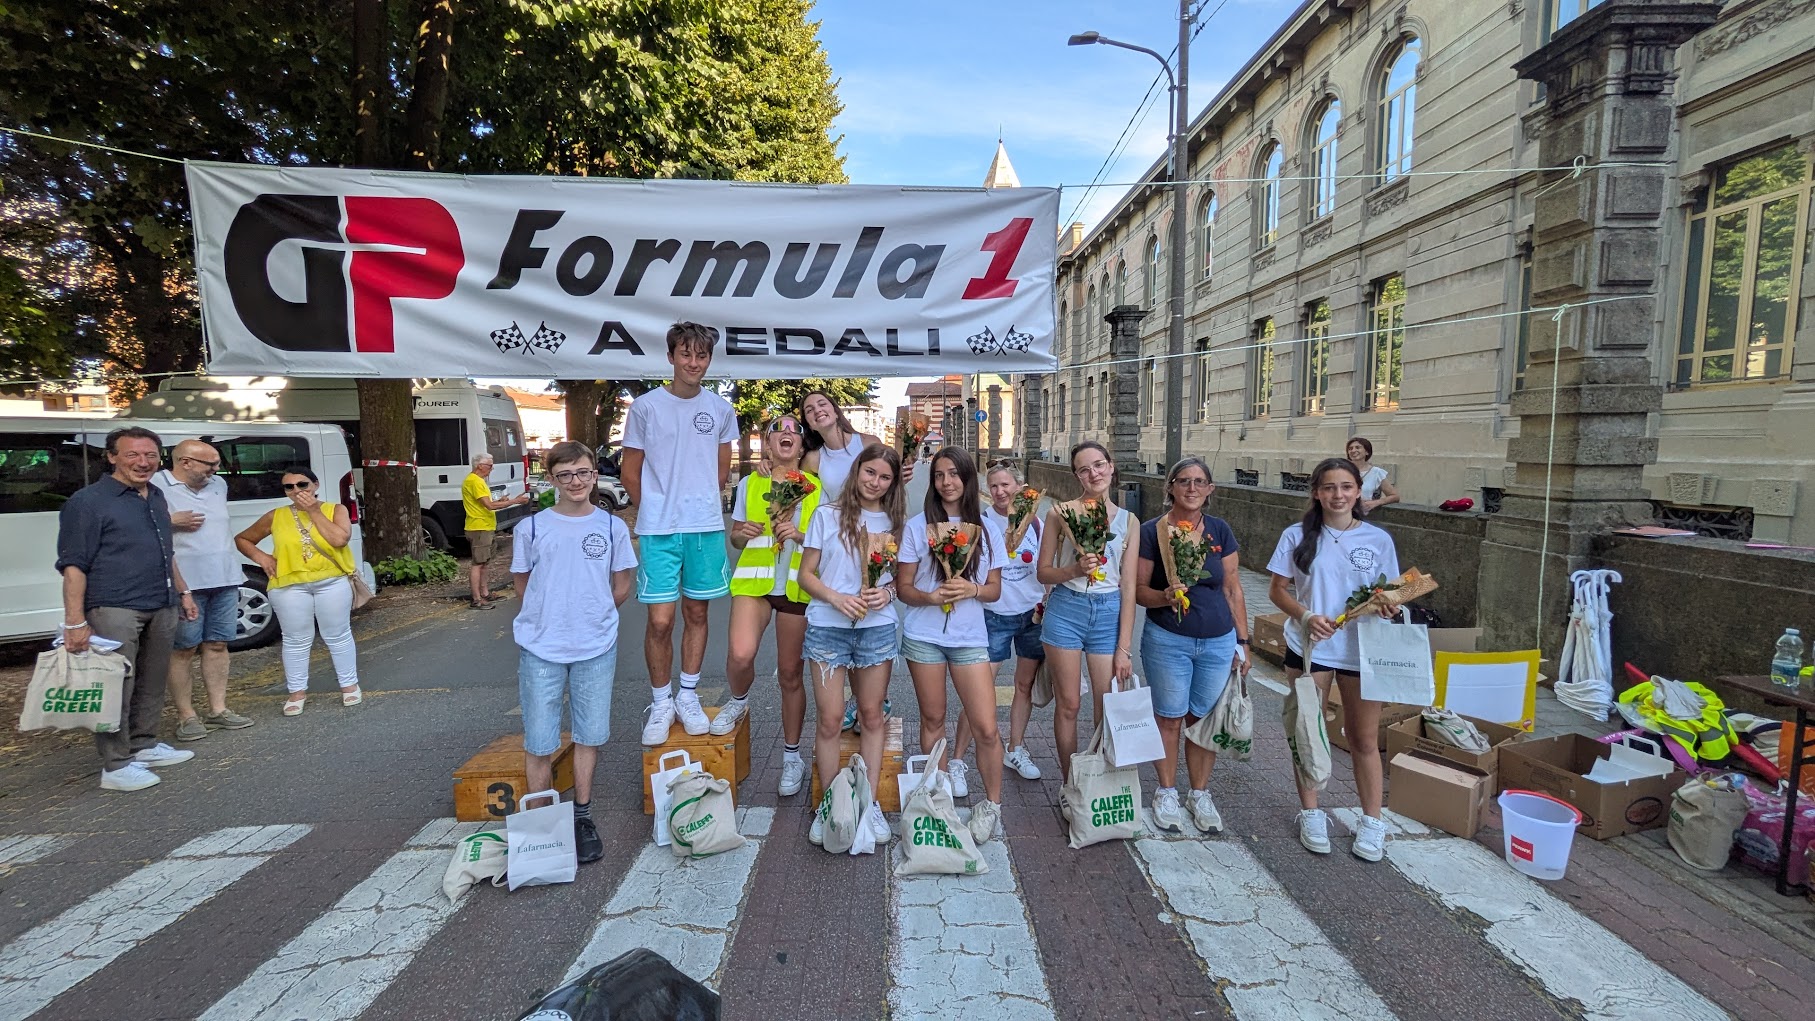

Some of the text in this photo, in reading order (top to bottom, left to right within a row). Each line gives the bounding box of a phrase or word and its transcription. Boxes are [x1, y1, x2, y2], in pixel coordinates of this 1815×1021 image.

[486, 208, 1035, 300] Formula 1
[587, 320, 941, 356] A EDALI
[45, 687, 103, 701] CALEFFI
[42, 700, 102, 713] GREEN
[1121, 785, 1131, 793] THE
[487, 782, 516, 817] 3
[1091, 794, 1133, 813] CALEFFI
[1092, 809, 1135, 828] GREEN
[517, 841, 566, 854] Lafarmacia.
